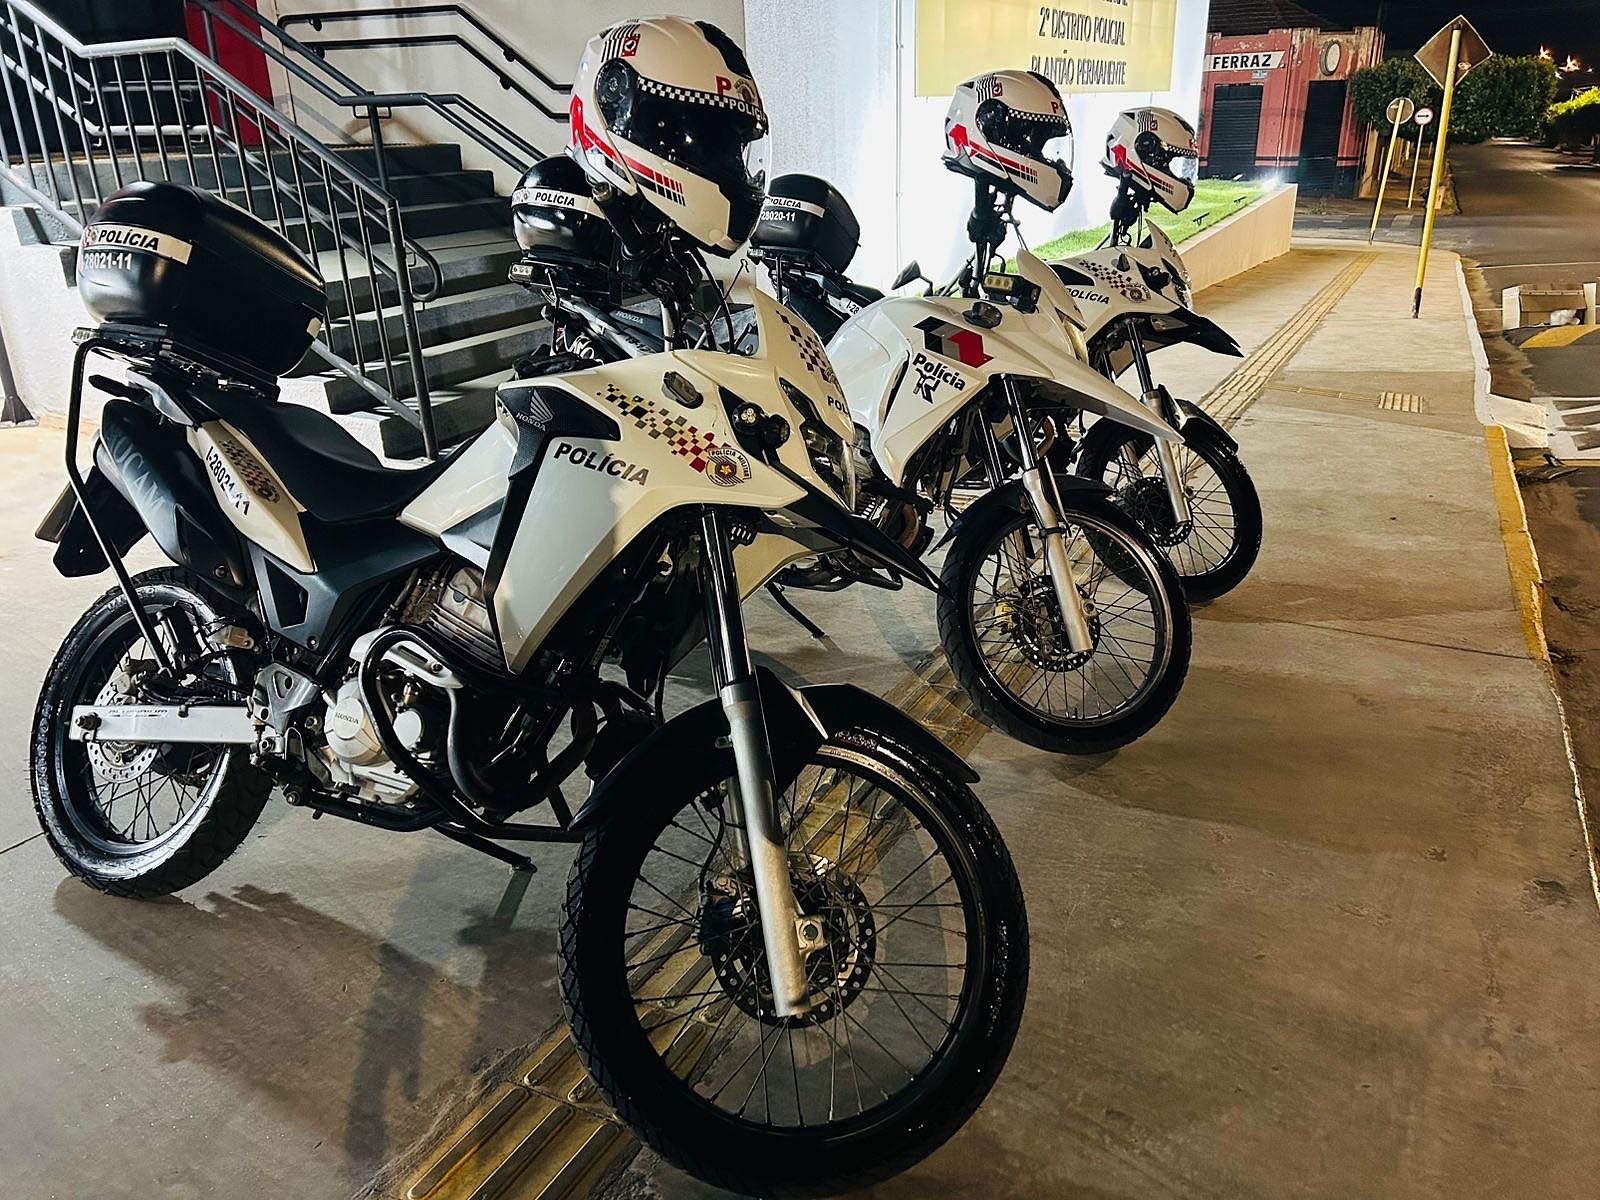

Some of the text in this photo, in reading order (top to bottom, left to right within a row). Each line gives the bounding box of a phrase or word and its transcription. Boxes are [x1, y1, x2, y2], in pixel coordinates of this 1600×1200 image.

[1051, 9, 1092, 42] DISTRITO
[1093, 16, 1126, 45] POLICIAL
[1076, 58, 1127, 85] PERMANENTE
[1213, 54, 1272, 69] FERRAZ
[715, 75, 732, 96] P
[98, 229, 160, 251] POLÍCIA
[615, 310, 644, 325] HONDA
[912, 352, 966, 391] Polícia
[515, 411, 547, 432] HONDA
[553, 442, 650, 486] POLÍCIA
